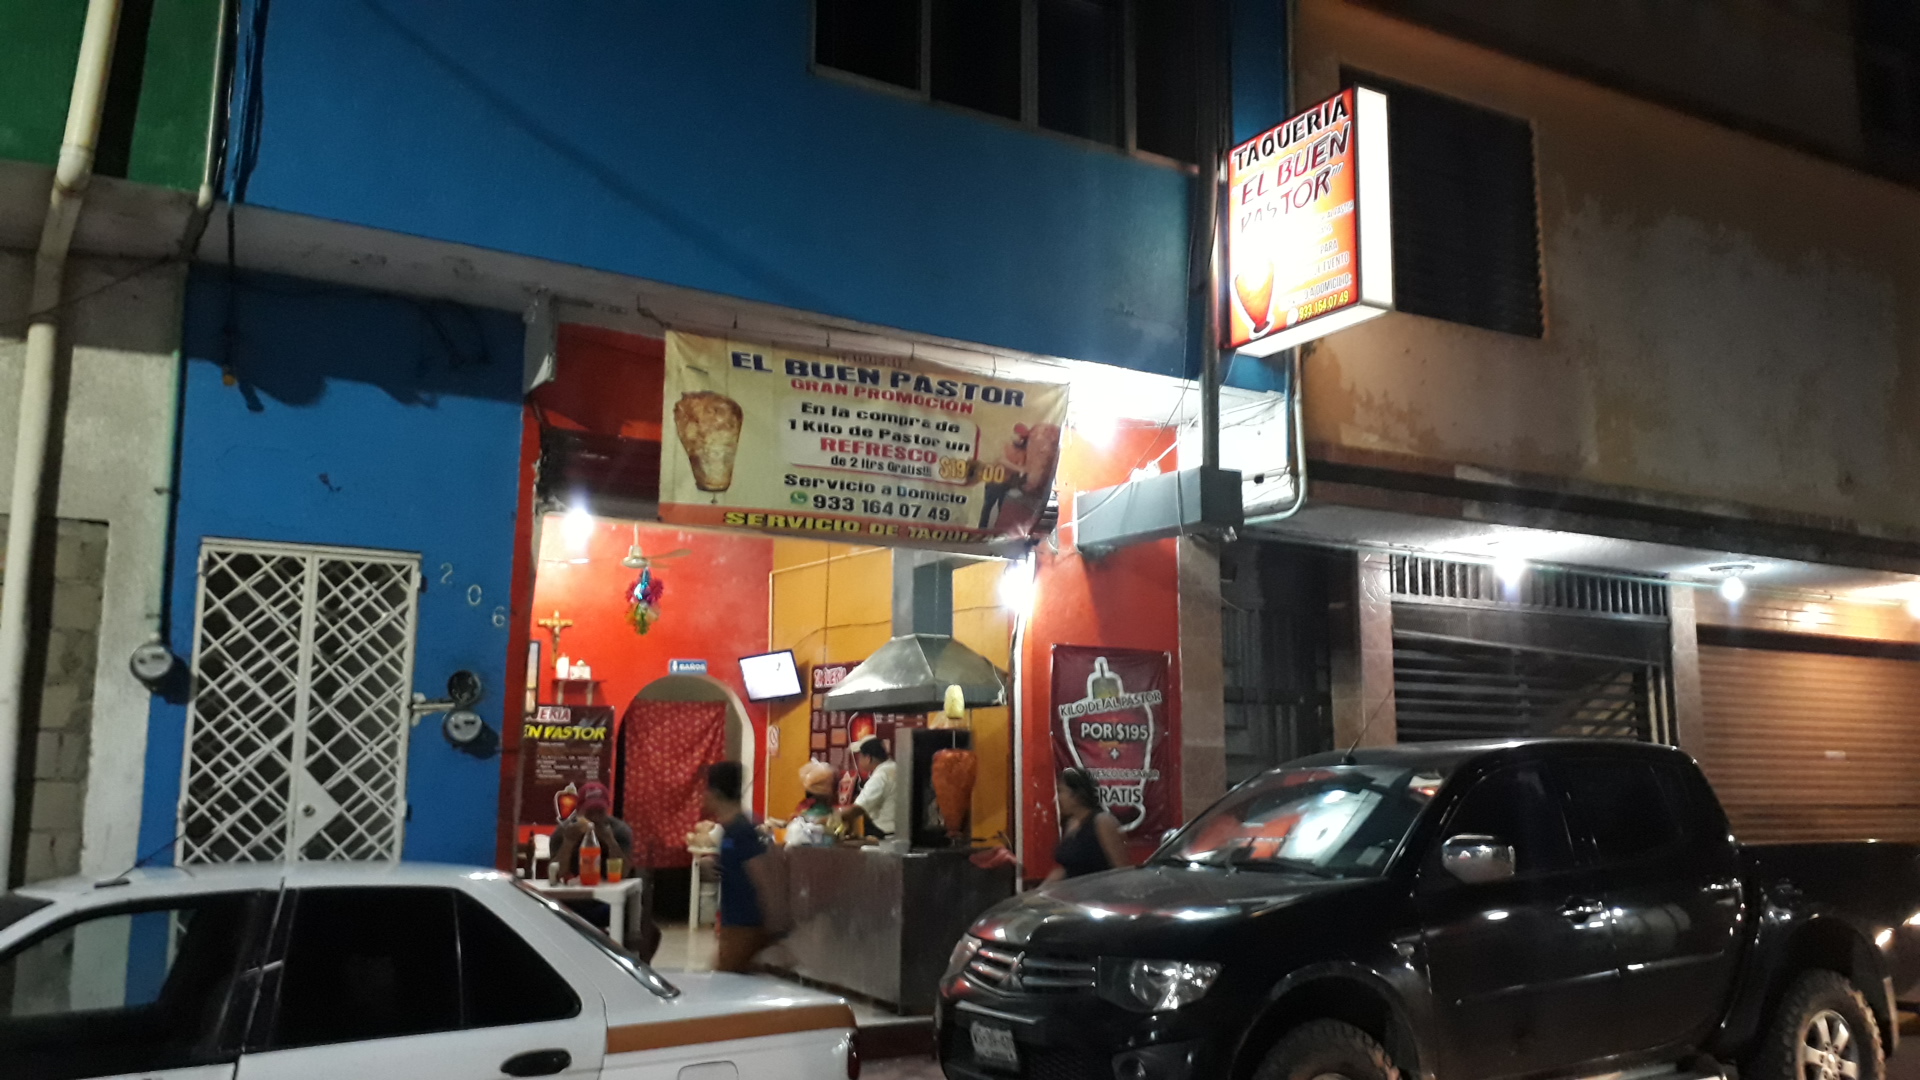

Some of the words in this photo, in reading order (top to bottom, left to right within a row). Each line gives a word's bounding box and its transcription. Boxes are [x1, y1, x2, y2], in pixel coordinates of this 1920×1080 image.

[1231, 96, 1349, 170] TAQUERIA
[1241, 171, 1269, 205] EL
[1276, 123, 1351, 187] BUEN
[731, 351, 773, 373] EL
[785, 358, 880, 386] BUEN
[890, 370, 1025, 408] PASTOR
[790, 378, 848, 396] GRAN
[801, 401, 825, 416] En
[832, 405, 850, 418] la
[856, 410, 930, 429] compra
[935, 420, 961, 433] de
[789, 419, 797, 430] 1
[803, 420, 842, 434] Kilo
[849, 426, 873, 438] de
[879, 428, 940, 448] Pastor
[945, 440, 970, 452] un
[820, 437, 938, 465] REFRESCO
[831, 455, 846, 467] de
[850, 457, 858, 468] 2
[784, 474, 876, 494] Servicio
[881, 485, 892, 496] a
[813, 494, 855, 513] 933
[862, 499, 894, 517] 164
[899, 503, 922, 519] 07
[927, 506, 950, 521] 49
[723, 511, 861, 533] SERVICIO
[869, 523, 899, 536] DE
[1060, 702, 1086, 717] KILO
[1120, 690, 1162, 707] PASTOR
[543, 725, 607, 740] PASTOR
[1081, 722, 1113, 739] POR
[1116, 722, 1149, 740] $195
[1099, 787, 1142, 804] RATIS
